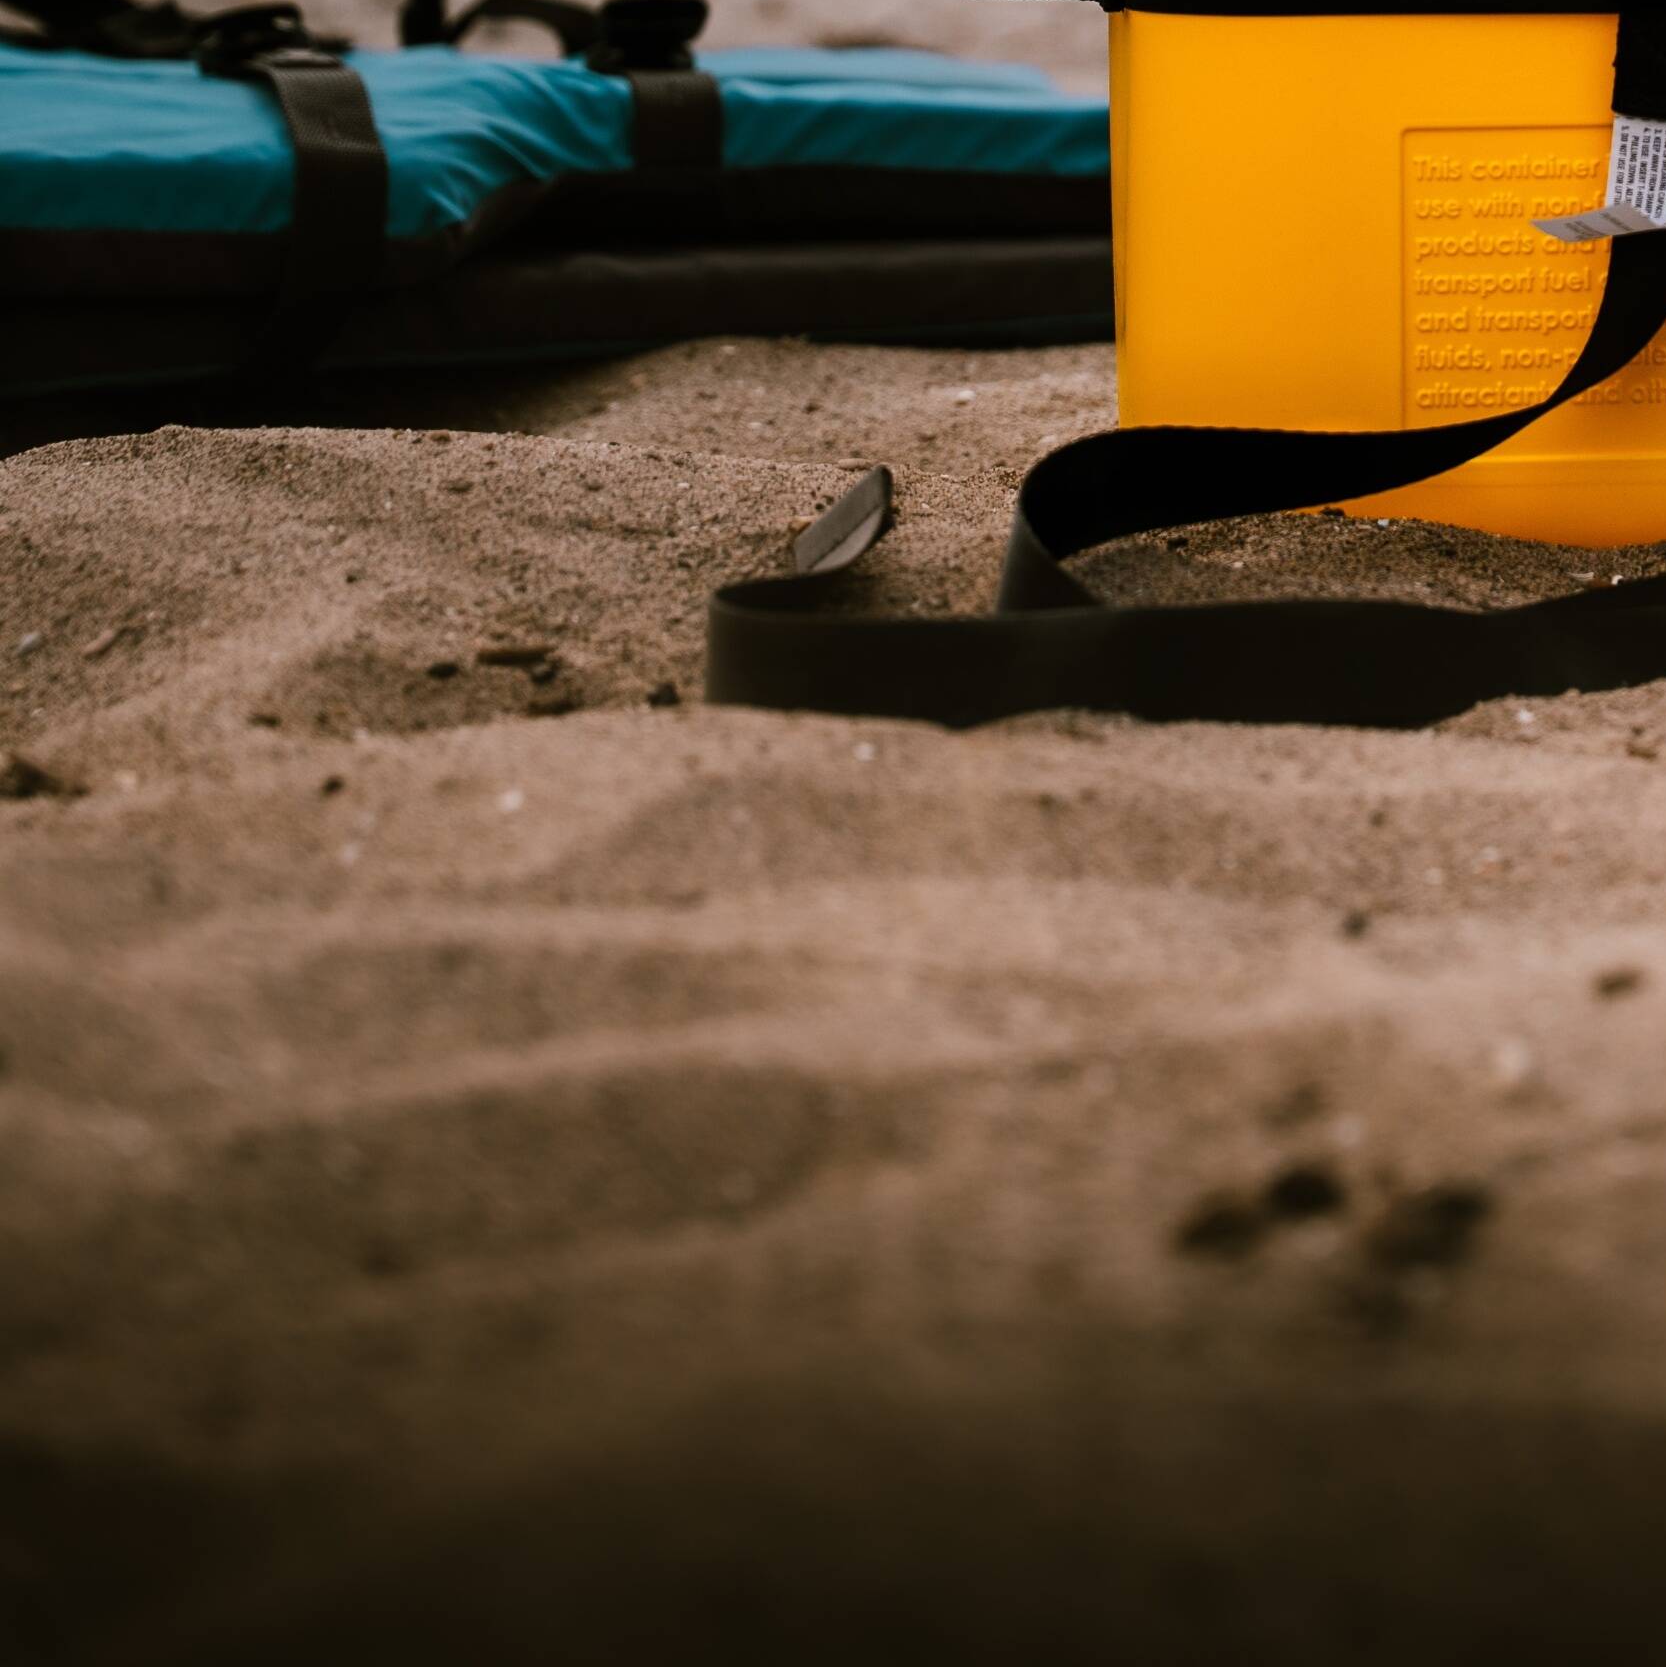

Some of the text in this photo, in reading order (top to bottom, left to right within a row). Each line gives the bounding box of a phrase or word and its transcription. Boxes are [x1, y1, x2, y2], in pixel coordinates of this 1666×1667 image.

[1413, 155, 1461, 181] This
[1470, 152, 1600, 180] container
[1414, 196, 1461, 219] use
[1468, 192, 1524, 218] with
[1414, 231, 1535, 261] products
[1414, 268, 1535, 298] transport
[1541, 266, 1591, 292] fuel
[1415, 305, 1469, 333] and
